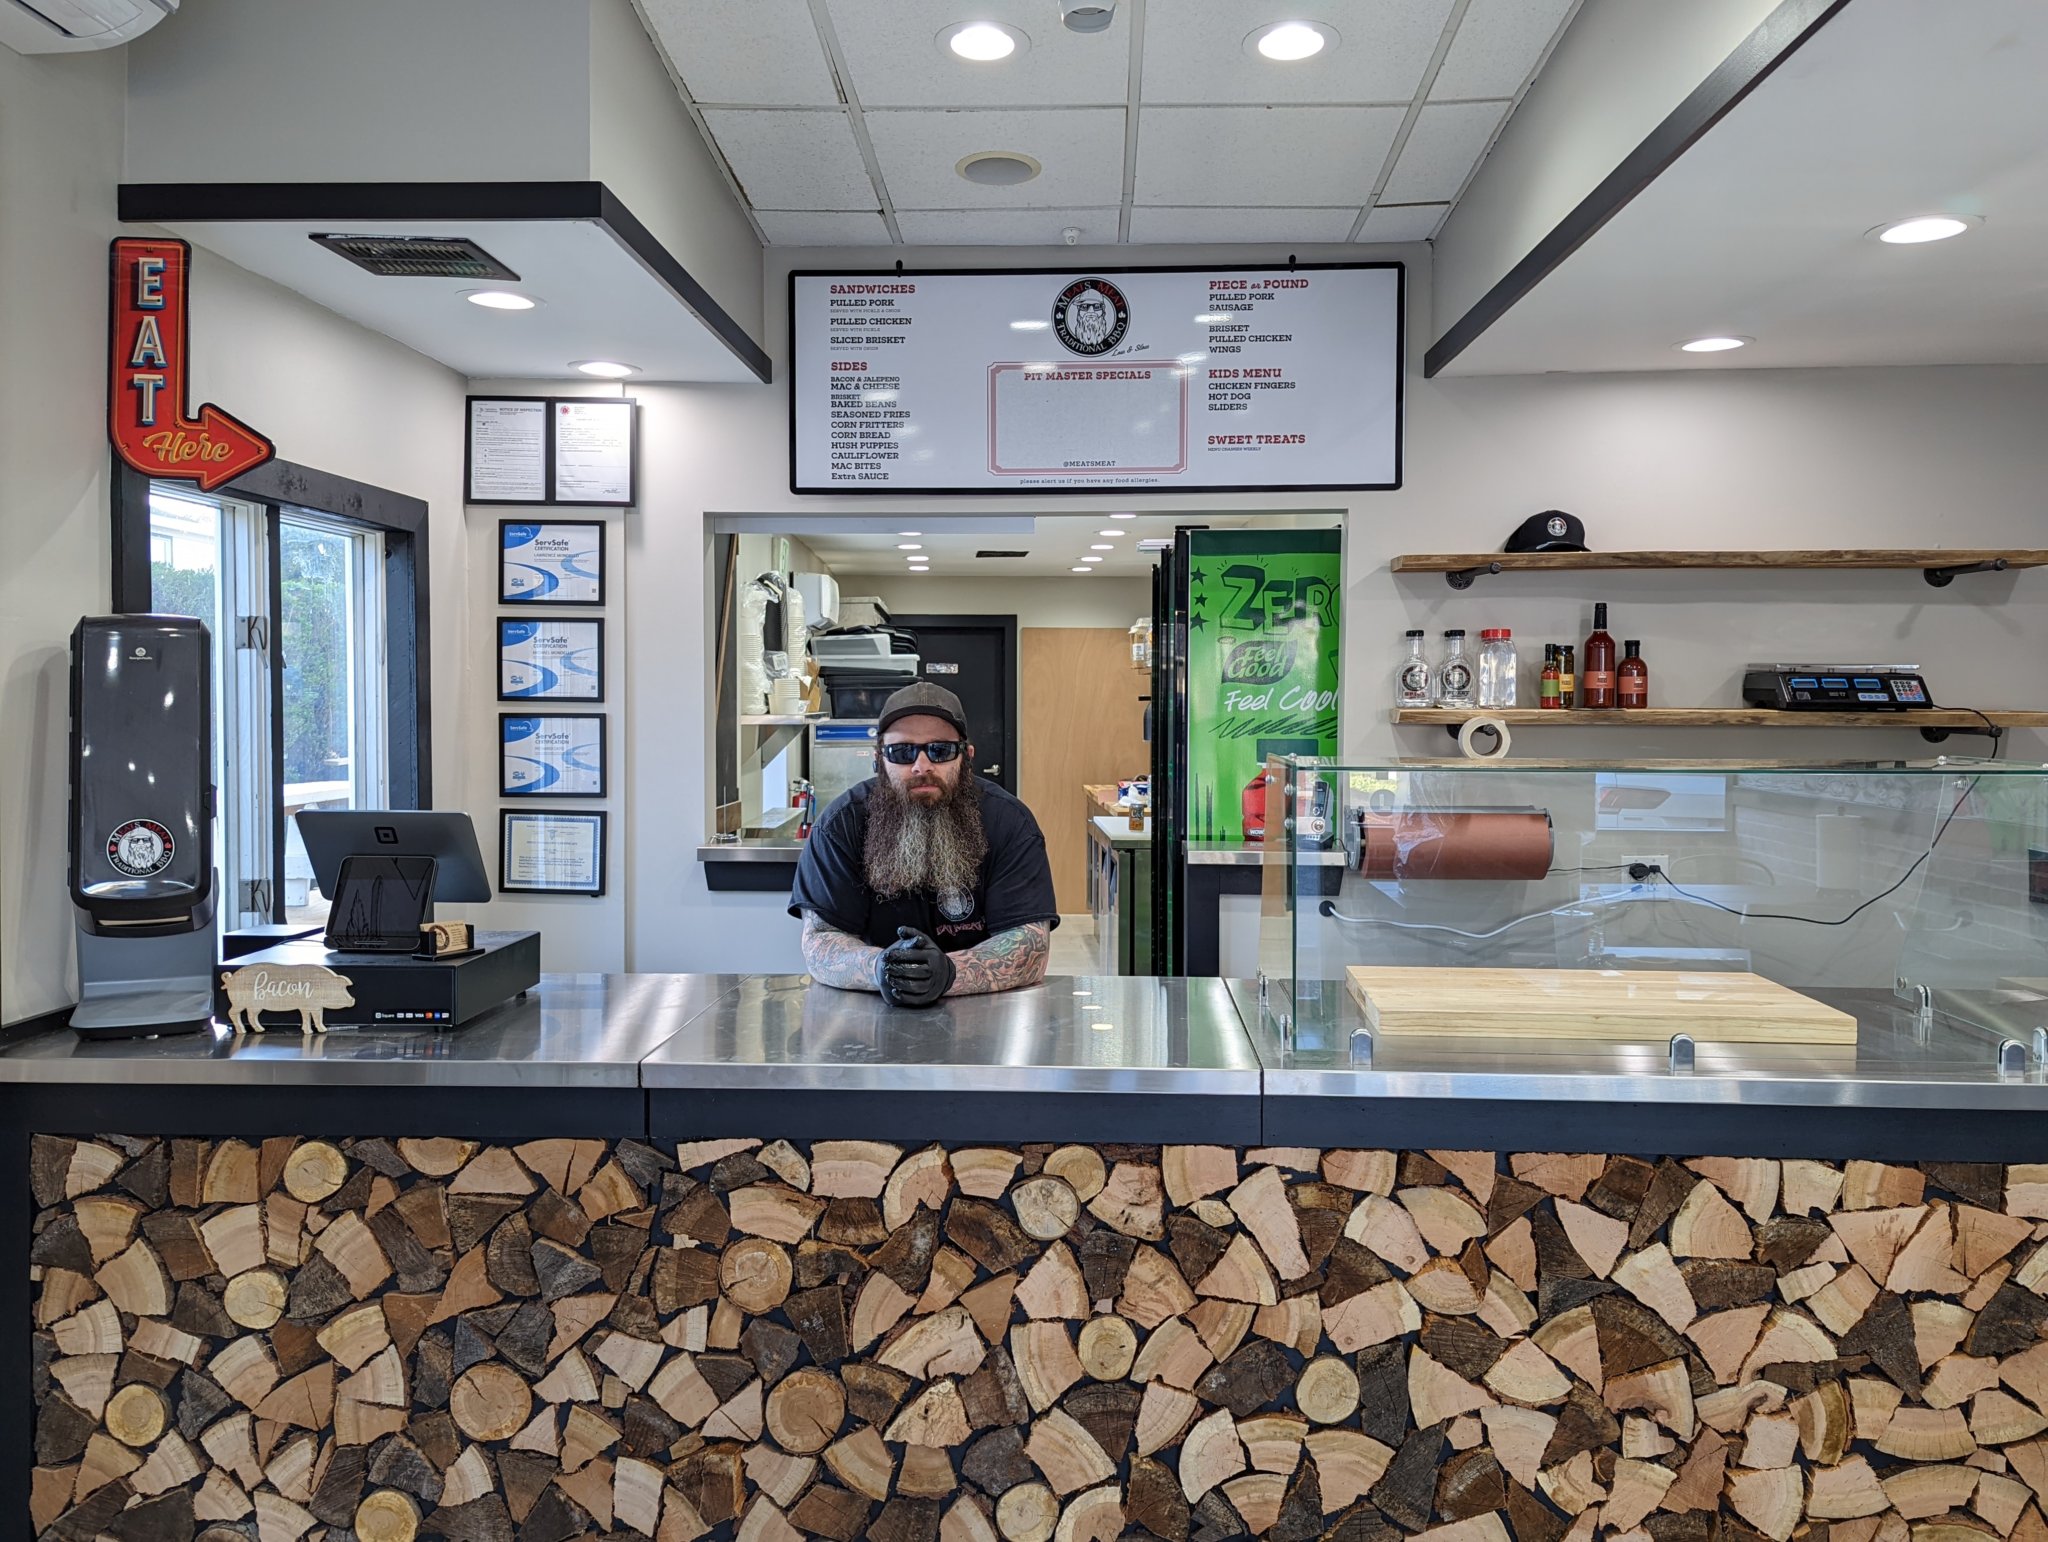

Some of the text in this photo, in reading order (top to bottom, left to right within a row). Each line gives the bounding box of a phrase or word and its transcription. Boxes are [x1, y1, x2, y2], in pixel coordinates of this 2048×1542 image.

[830, 284, 916, 294] SANDWICHES
[1209, 280, 1247, 290] PIECE
[1263, 279, 1309, 289] POUND
[1057, 281, 1125, 310] MEATS MEAT
[1209, 293, 1247, 301] PULLED
[869, 317, 912, 325] CHICKEN
[131, 256, 167, 426] EAT
[830, 336, 906, 344] SLICED BRISKET
[1057, 321, 1126, 353] TRADITIONAL BBQ
[1209, 334, 1292, 343] PULLED CHICKEN
[831, 362, 868, 372] SIDES
[1024, 370, 1151, 380] PIT MASTER SPECIALS
[1208, 368, 1282, 379] KIDS MENU
[1208, 382, 1296, 390] CHICKEN FINGERS
[1208, 393, 1228, 401] HOT
[1208, 403, 1248, 411] SLIDERS
[1207, 434, 1306, 445] SWEET TREATS
[142, 431, 234, 464] Here
[831, 452, 899, 460] CAULIFLOWER
[831, 462, 882, 470] MAC BITES
[831, 472, 889, 480] Extra SAUCE
[533, 636, 568, 644] ServSafe
[1241, 643, 1285, 666] Feel
[1228, 655, 1288, 679] Good
[1223, 686, 1339, 713] Feel Cool
[111, 821, 170, 844] MEATS MEAT
[111, 850, 172, 874] TRADITIONAL BBQ
[253, 971, 314, 1000] bacon
